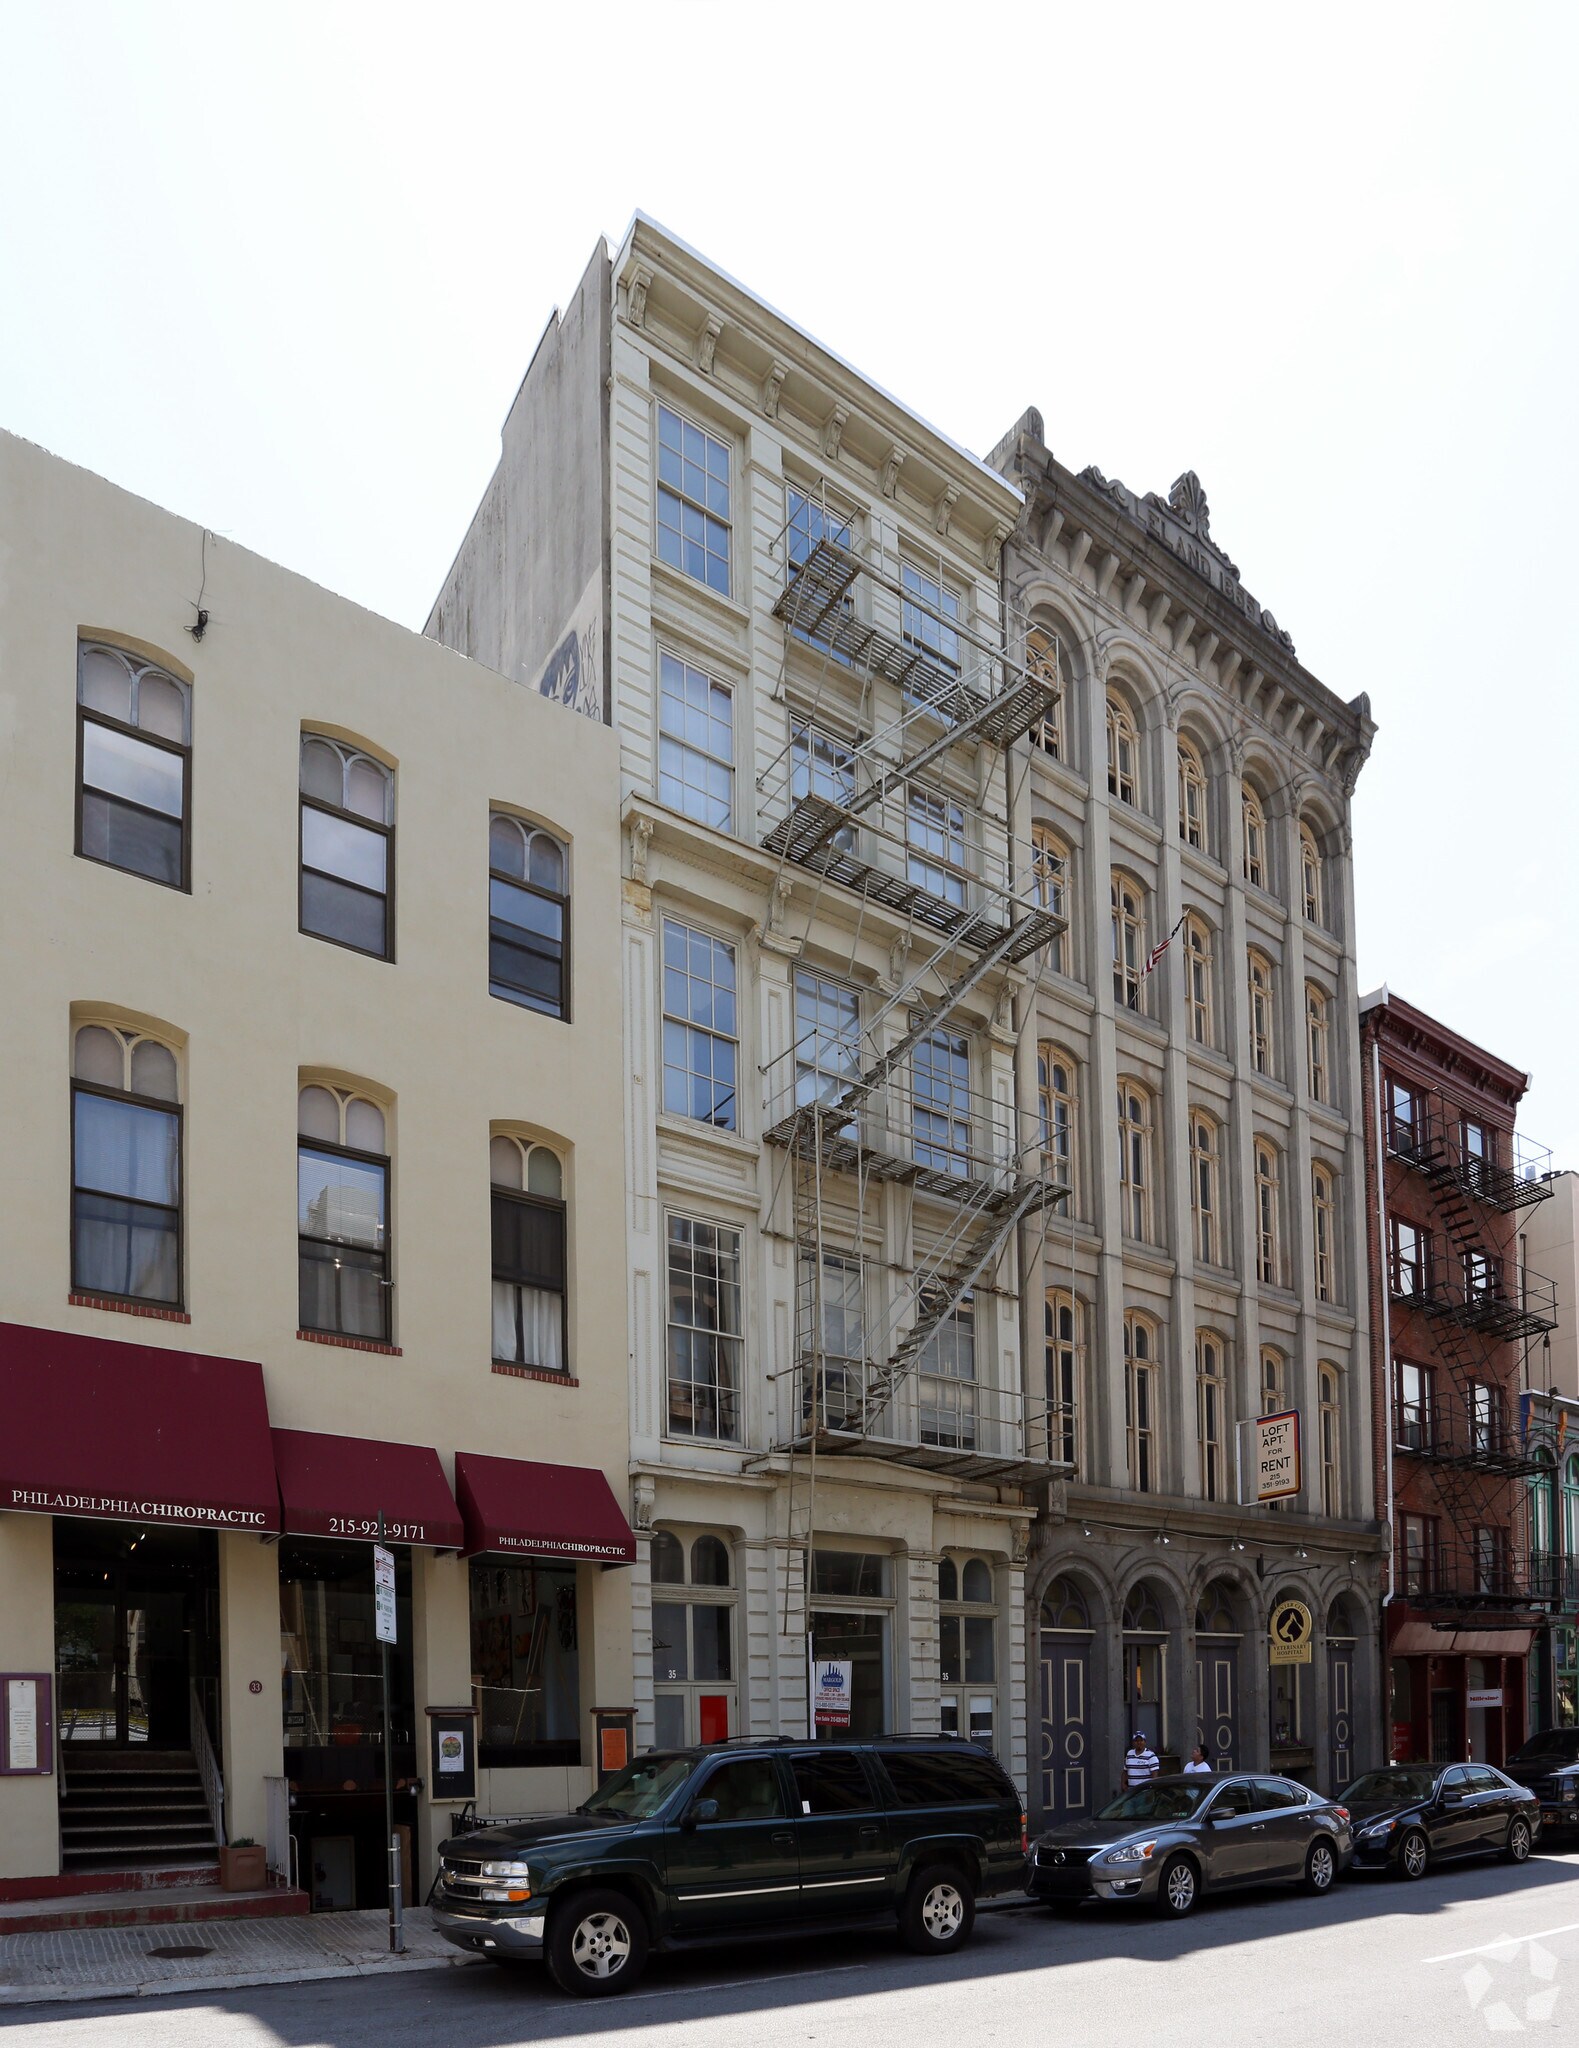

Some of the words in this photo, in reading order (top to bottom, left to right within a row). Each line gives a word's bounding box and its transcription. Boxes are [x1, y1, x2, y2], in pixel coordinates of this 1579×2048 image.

[1135, 497, 1211, 580] LELAND
[1262, 1423, 1290, 1437] LOFT
[1262, 1435, 1286, 1448] APT.
[1268, 1447, 1283, 1456] FOR
[1261, 1456, 1291, 1473] RENT
[668, 1669, 677, 1679] 35
[942, 1672, 949, 1681] 35
[251, 1682, 260, 1691] 33
